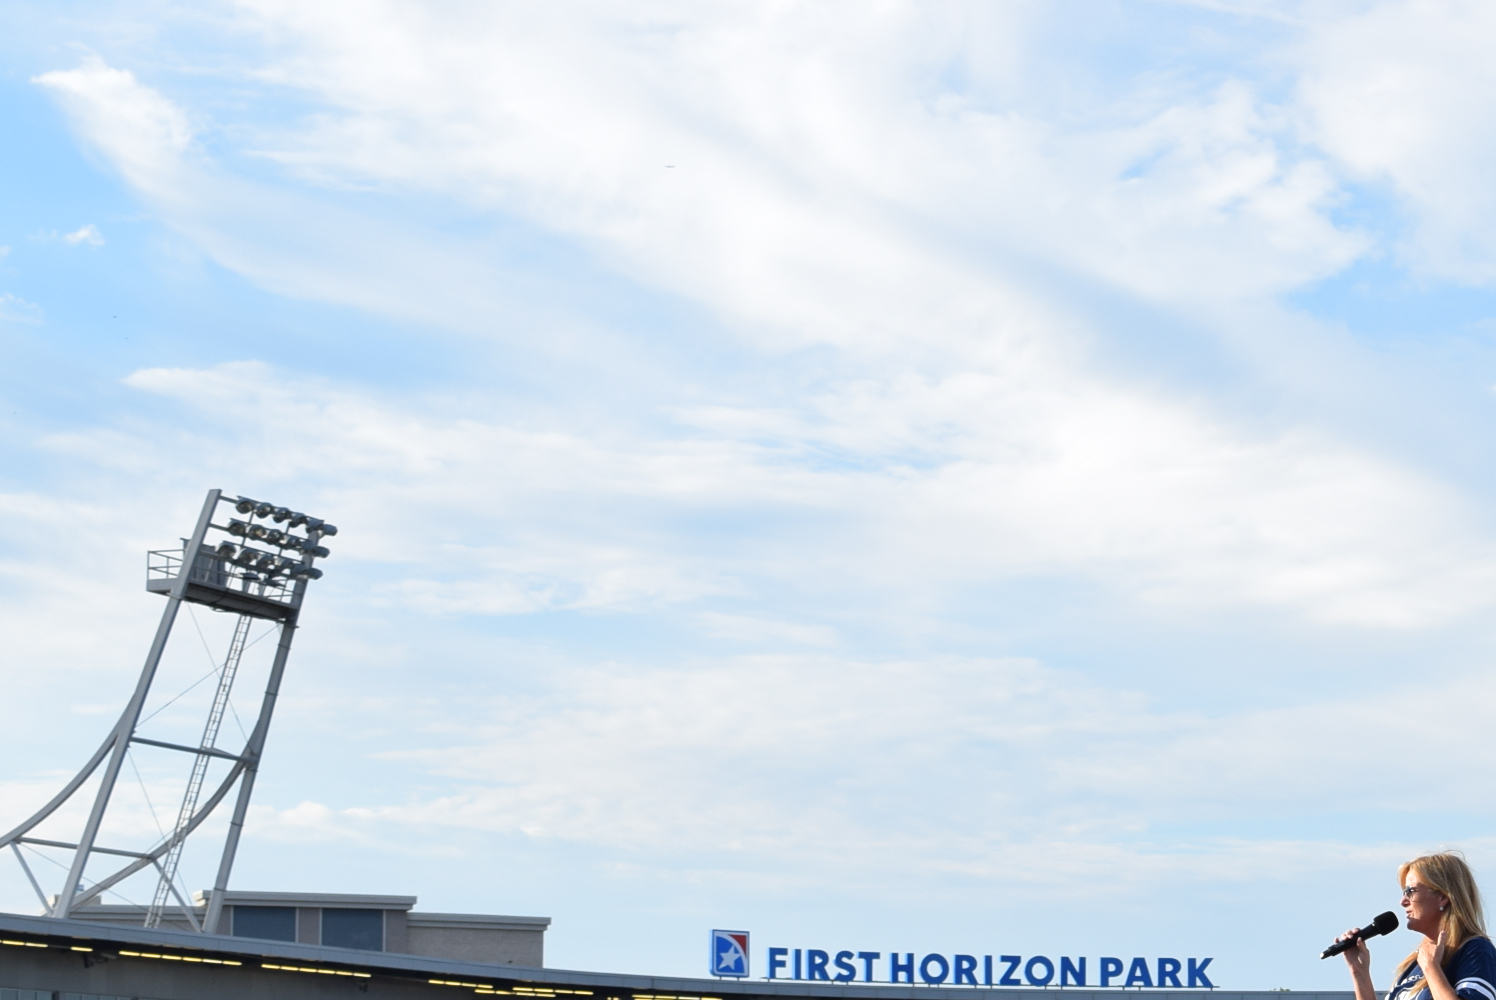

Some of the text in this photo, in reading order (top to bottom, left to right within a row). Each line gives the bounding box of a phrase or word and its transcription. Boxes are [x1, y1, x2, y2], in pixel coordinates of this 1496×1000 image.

[766, 946, 1214, 989] FIRST HORIZON PARK
